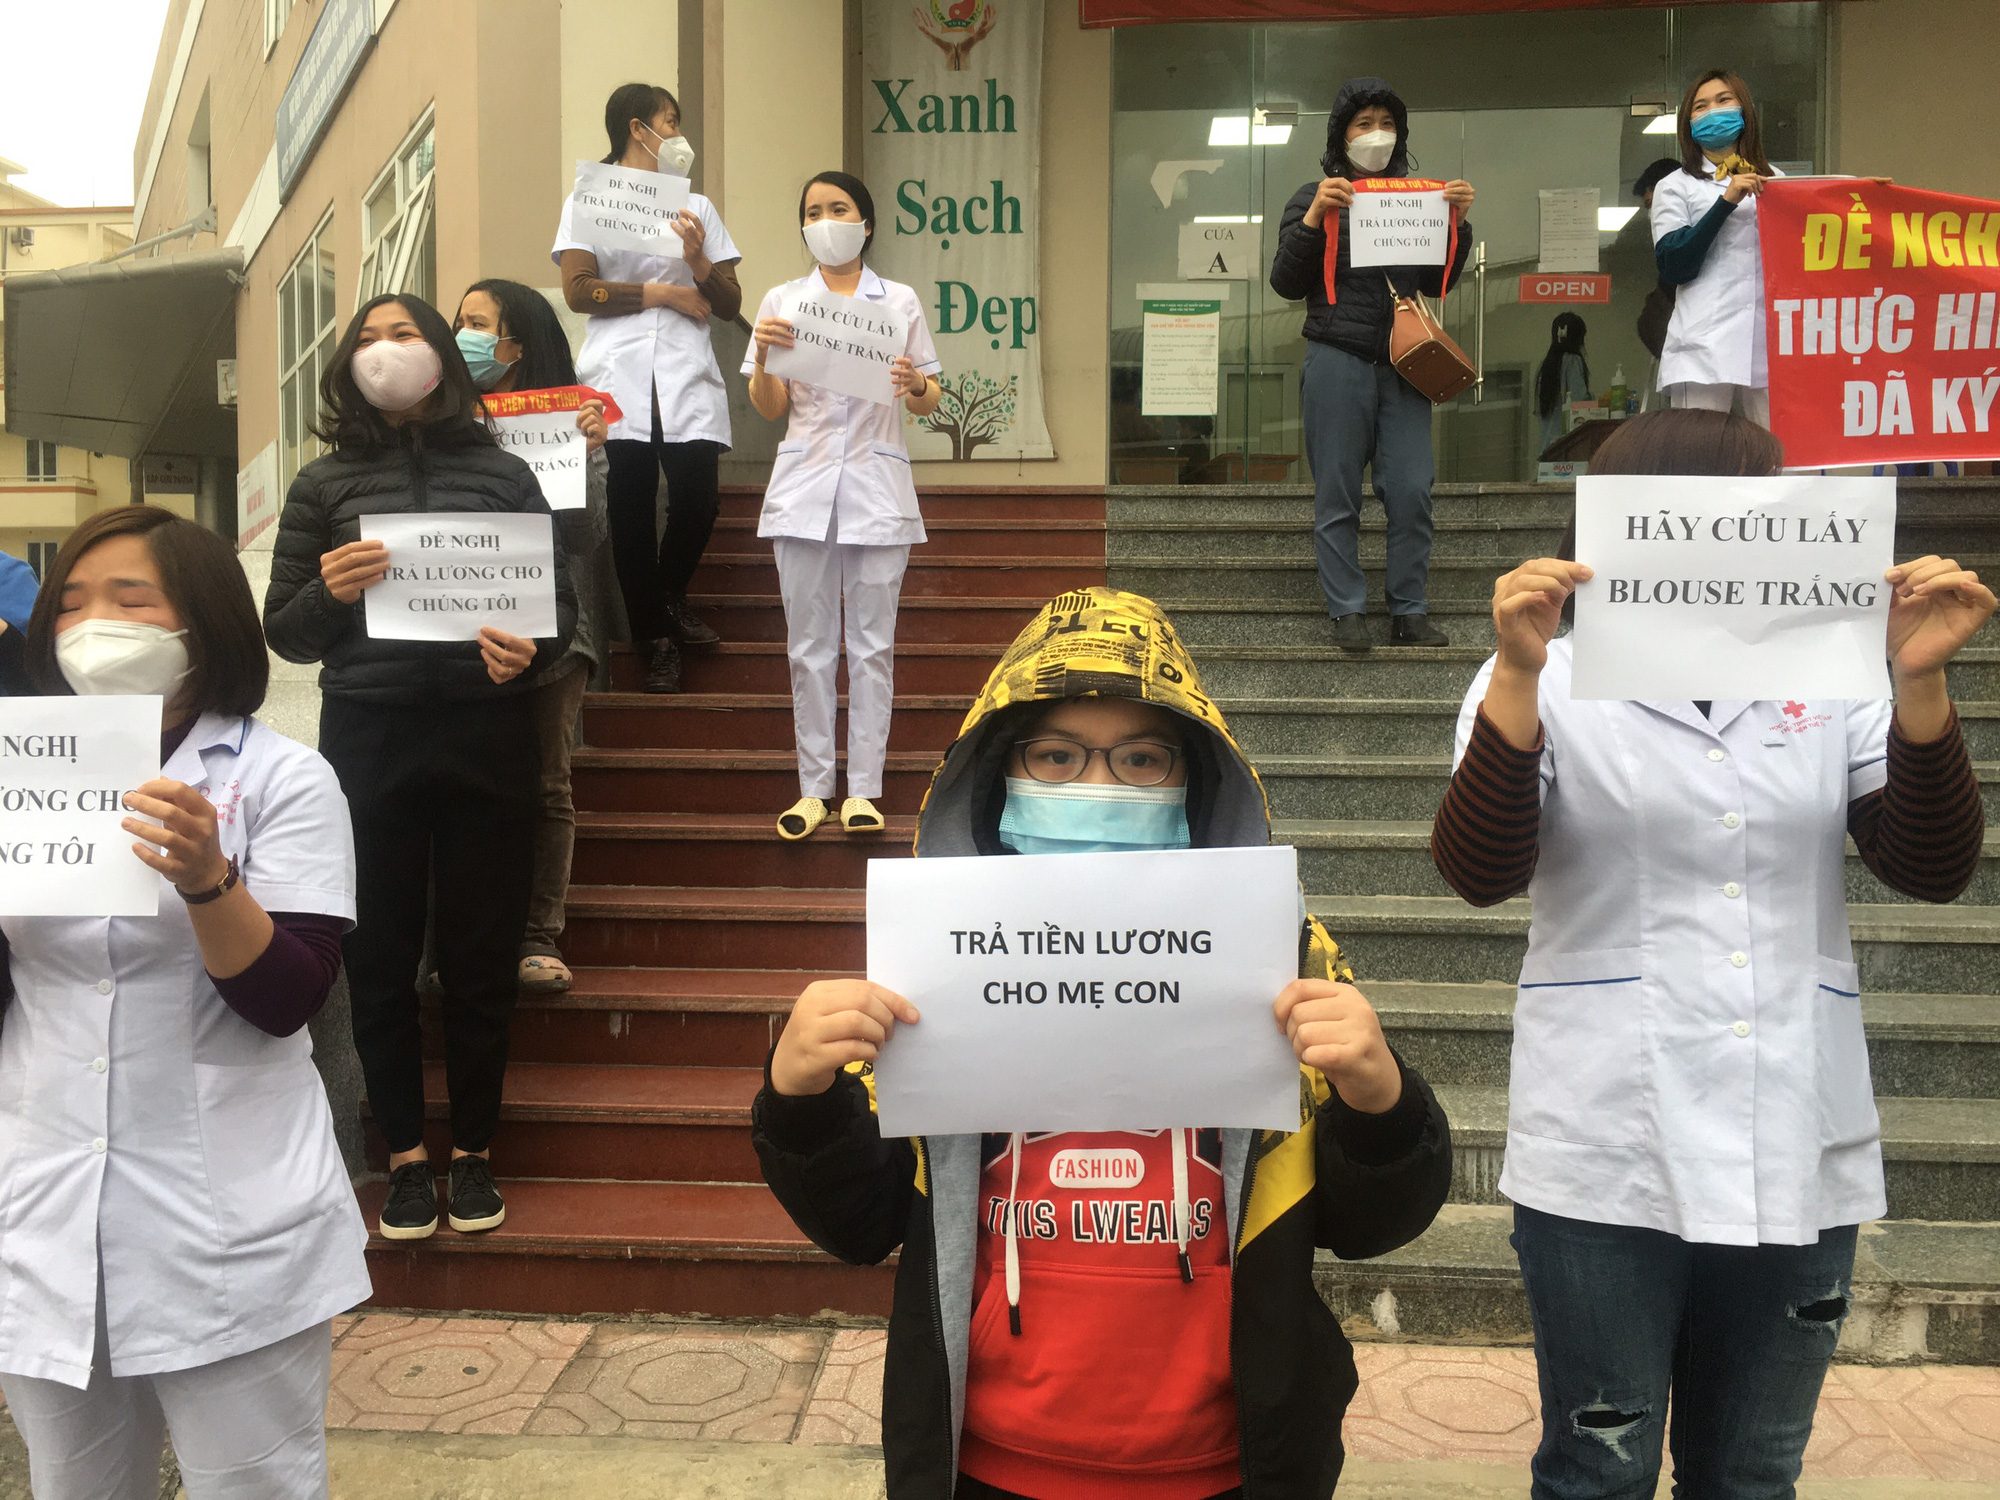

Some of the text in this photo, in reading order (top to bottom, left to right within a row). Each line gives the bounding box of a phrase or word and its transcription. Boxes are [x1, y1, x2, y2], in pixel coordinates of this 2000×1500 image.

[872, 78, 1018, 134] Xanh
[626, 181, 658, 199] NGHỊ
[608, 199, 651, 216] LƯƠNG
[653, 208, 680, 222] CHO
[896, 179, 1024, 250] Sạch
[1396, 199, 1423, 210] NGHỊ
[595, 216, 661, 237] CHÚNG TÔI
[1383, 218, 1420, 229] LƯƠNG
[1422, 218, 1445, 229] CHO
[1801, 192, 1873, 272] ĐỀ
[1373, 235, 1431, 248] CHÚNG TÔI
[1206, 251, 1230, 274] A
[1535, 281, 1596, 297] OPEN
[797, 300, 830, 321] HÃY
[831, 310, 865, 331] CỨU
[934, 281, 1036, 350] Đẹp
[1773, 287, 2000, 366] THỰC HI
[1841, 366, 2000, 438] ĐÃ KÝ
[1624, 509, 1869, 544] HÃY CỨU LẤY
[450, 534, 501, 552] NGHỊ
[424, 565, 496, 581] LƯƠNG
[500, 566, 543, 580] CHO
[408, 594, 518, 612] CHÚNG TÔI
[1607, 573, 1878, 608] BLOUSE TRẮNG
[2, 734, 79, 764] NGHỊ
[42, 836, 97, 865] TÔI
[950, 921, 1212, 955] TRẢ TIỀN LƯƠNG
[983, 981, 1180, 1009] CHO MẸ CON
[1055, 1158, 1138, 1179] FASHION
